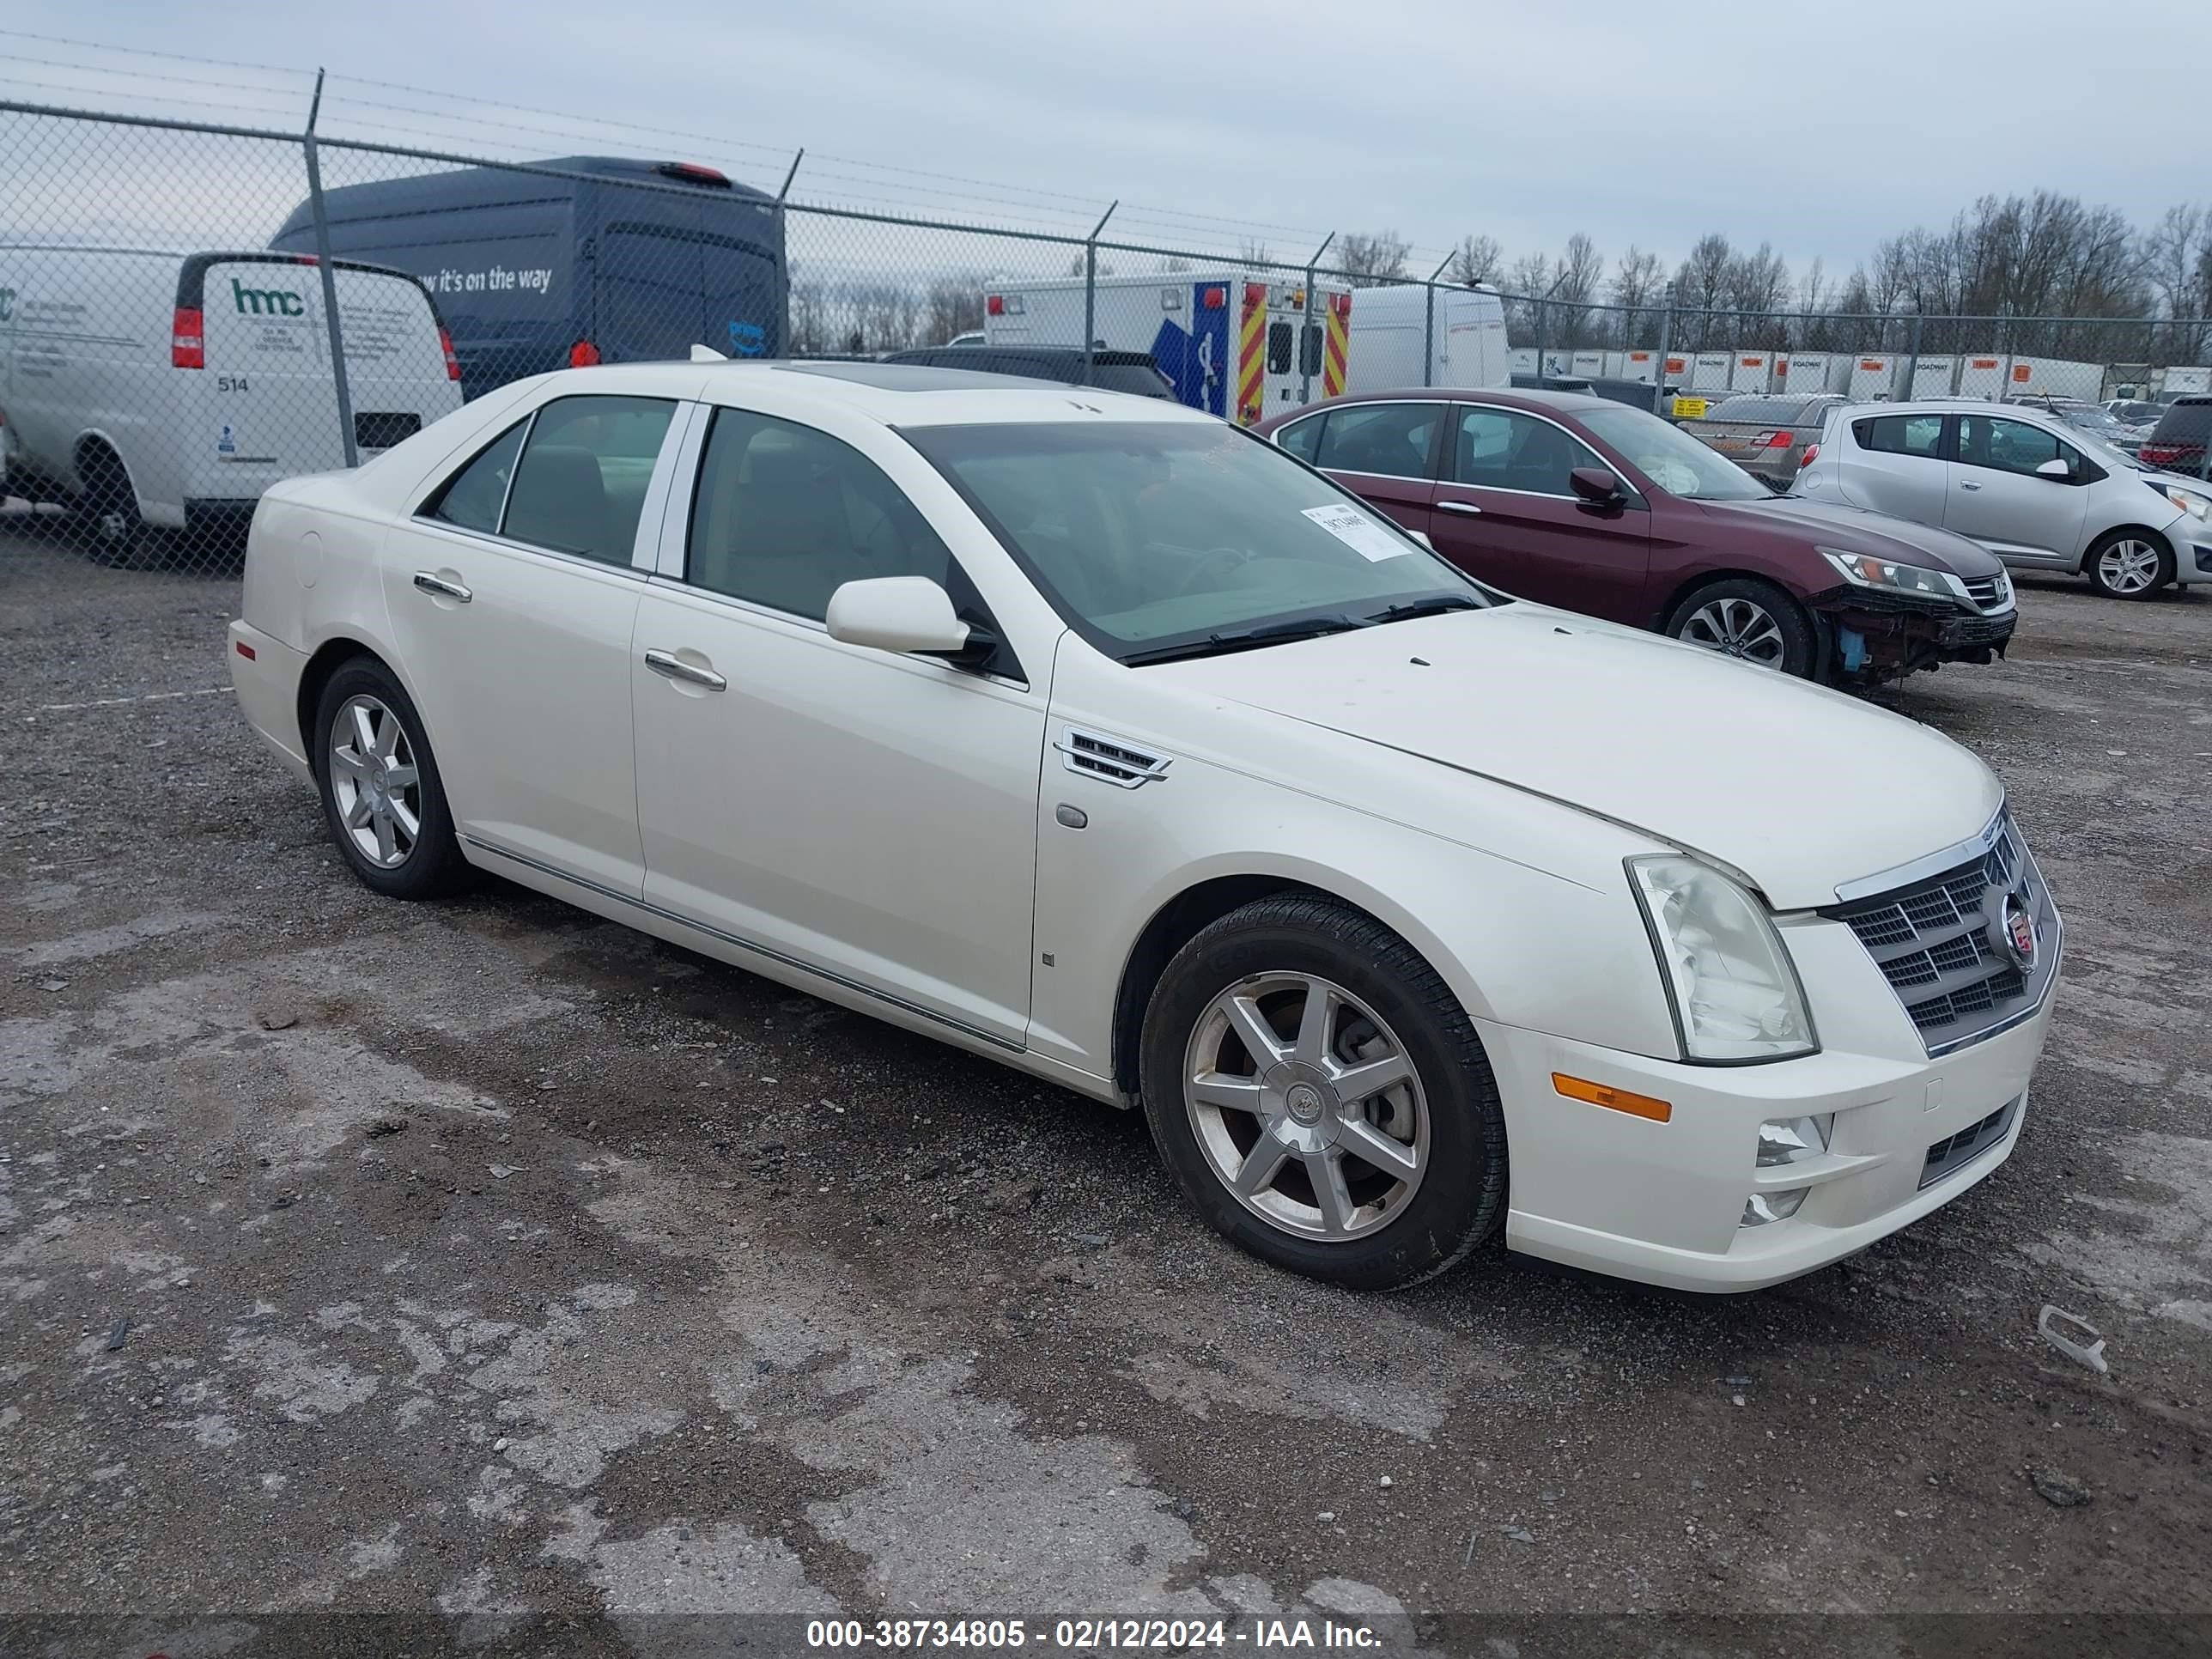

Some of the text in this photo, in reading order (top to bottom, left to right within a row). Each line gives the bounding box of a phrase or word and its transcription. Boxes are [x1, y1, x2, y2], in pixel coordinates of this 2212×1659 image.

[440, 268, 463, 292] it's
[465, 272, 485, 291] on
[489, 264, 515, 290] the
[519, 269, 552, 294] way
[232, 278, 303, 316] hmc
[218, 378, 248, 392] 514
